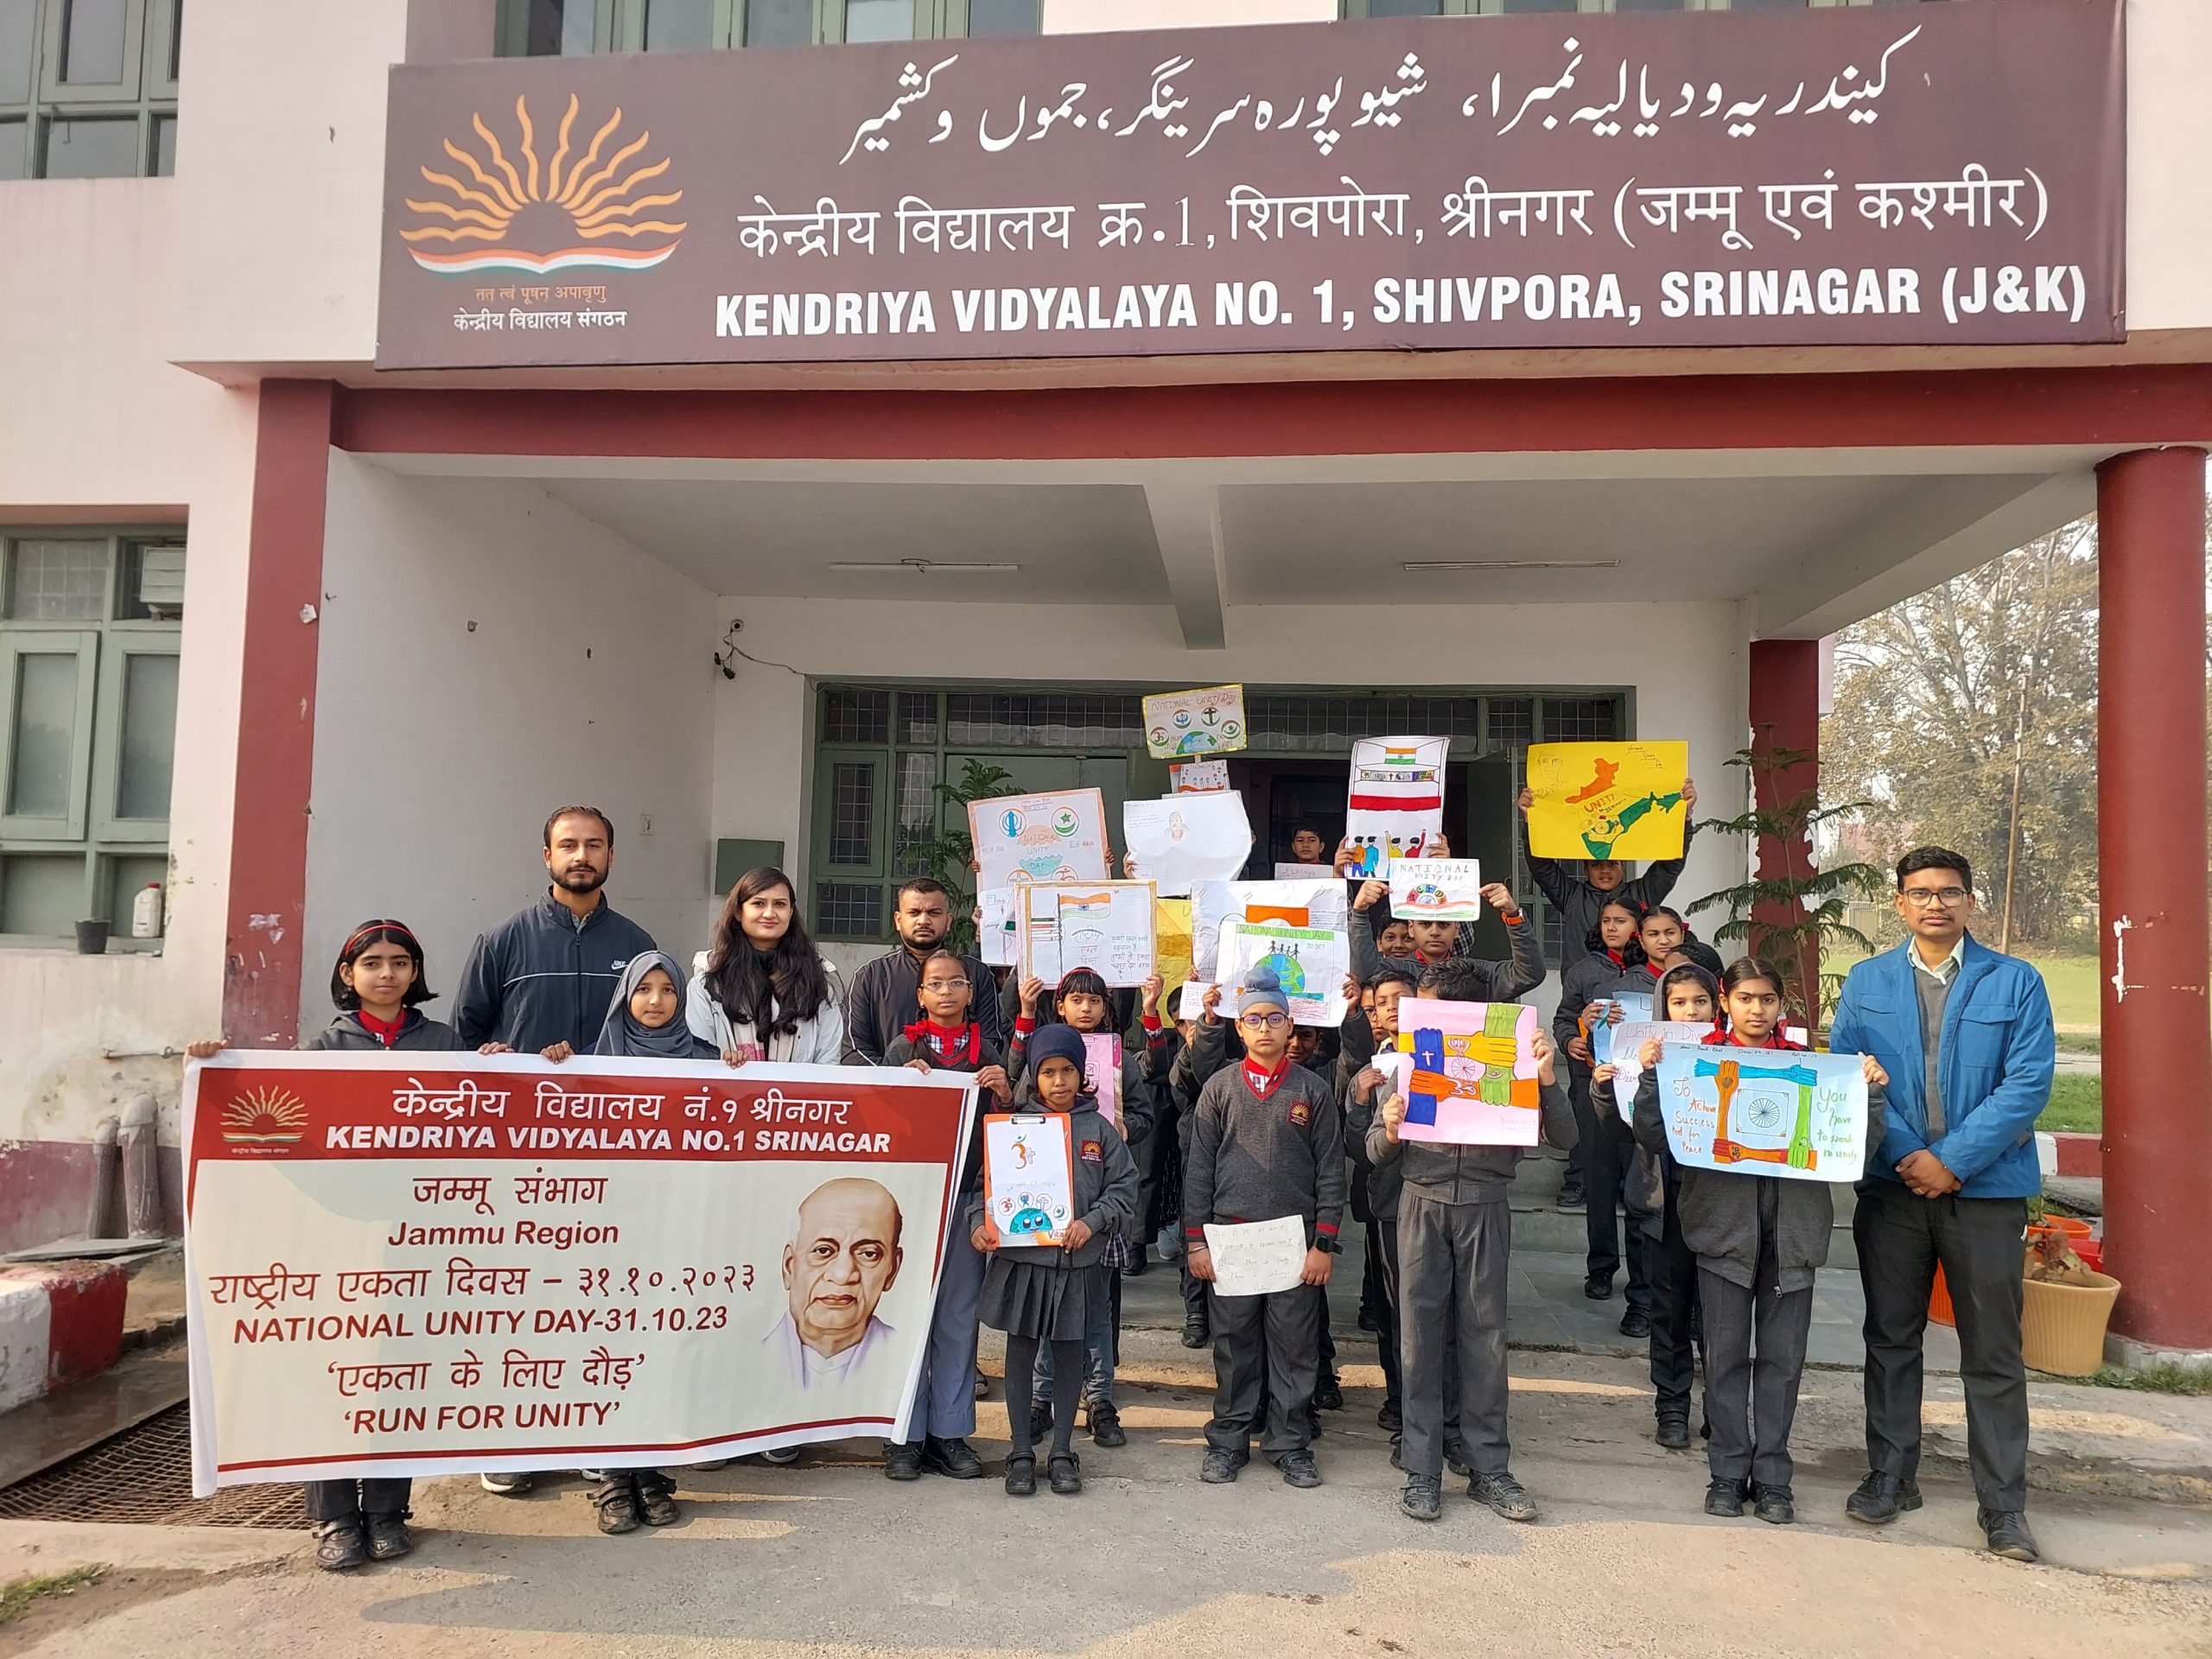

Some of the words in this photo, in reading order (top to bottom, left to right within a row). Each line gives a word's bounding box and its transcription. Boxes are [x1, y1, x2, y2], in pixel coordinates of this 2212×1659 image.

[838, 54, 958, 165] کشمیر
[979, 82, 1087, 152] جموں
[737, 194, 881, 258] केन्द्रीय
[893, 195, 1076, 254] विद्यालय
[1440, 175, 1594, 238] श्रीनगर
[1758, 168, 1840, 240] एवं
[1854, 162, 2048, 241] कश्मीर)
[715, 290, 937, 337] KENDRIYA
[951, 283, 1198, 332] VIDYALAYA
[1215, 280, 1293, 326] NO.
[1313, 279, 1354, 331] 1,
[1373, 273, 1641, 327] SHIVPORA,
[1661, 268, 1921, 318] SRINAGAR
[1942, 265, 2085, 324] (J&K)
[453, 307, 505, 331] केन्द्रीय
[508, 308, 574, 330] विद्यालय
[575, 308, 628, 328] संगठन
[1583, 793, 1615, 813] UNITY
[1026, 846, 1049, 855] UNITY
[1030, 861, 1045, 871] DAY
[1400, 864, 1469, 874] NATIONAL
[1414, 873, 1443, 881] UNITY
[1239, 925, 1275, 937] NATIONAL
[1663, 1028, 1674, 1039] in
[1674, 1077, 1690, 1096] To
[392, 1077, 512, 1121] केन्द्रीय
[534, 1081, 666, 1121] विद्यालय
[750, 1088, 853, 1124] श्रीनगर
[1817, 1087, 1847, 1112] You
[1675, 1111, 1714, 1128] Success
[326, 1126, 496, 1148] KENDRIYA
[507, 1127, 672, 1150] VIDYALAYA
[682, 1129, 745, 1151] NO.1
[754, 1130, 891, 1153] SRINAGAR
[1817, 1128, 1827, 1141] to
[1681, 1141, 1702, 1154] Peace
[412, 1177, 495, 1217] जम्मू
[513, 1166, 609, 1205] संभाग
[388, 1222, 505, 1246] Jammu
[514, 1220, 619, 1250] Region
[208, 1262, 321, 1311] राष्ट्रीय
[336, 1269, 433, 1302] एकता
[445, 1256, 531, 1296] दिवस
[234, 1313, 414, 1344] NATIONAL
[425, 1310, 525, 1336] UNITY
[533, 1306, 728, 1333] DAY-31.10.23
[449, 1348, 484, 1389] के
[501, 1348, 567, 1389] लिए
[437, 1404, 505, 1431] FOR
